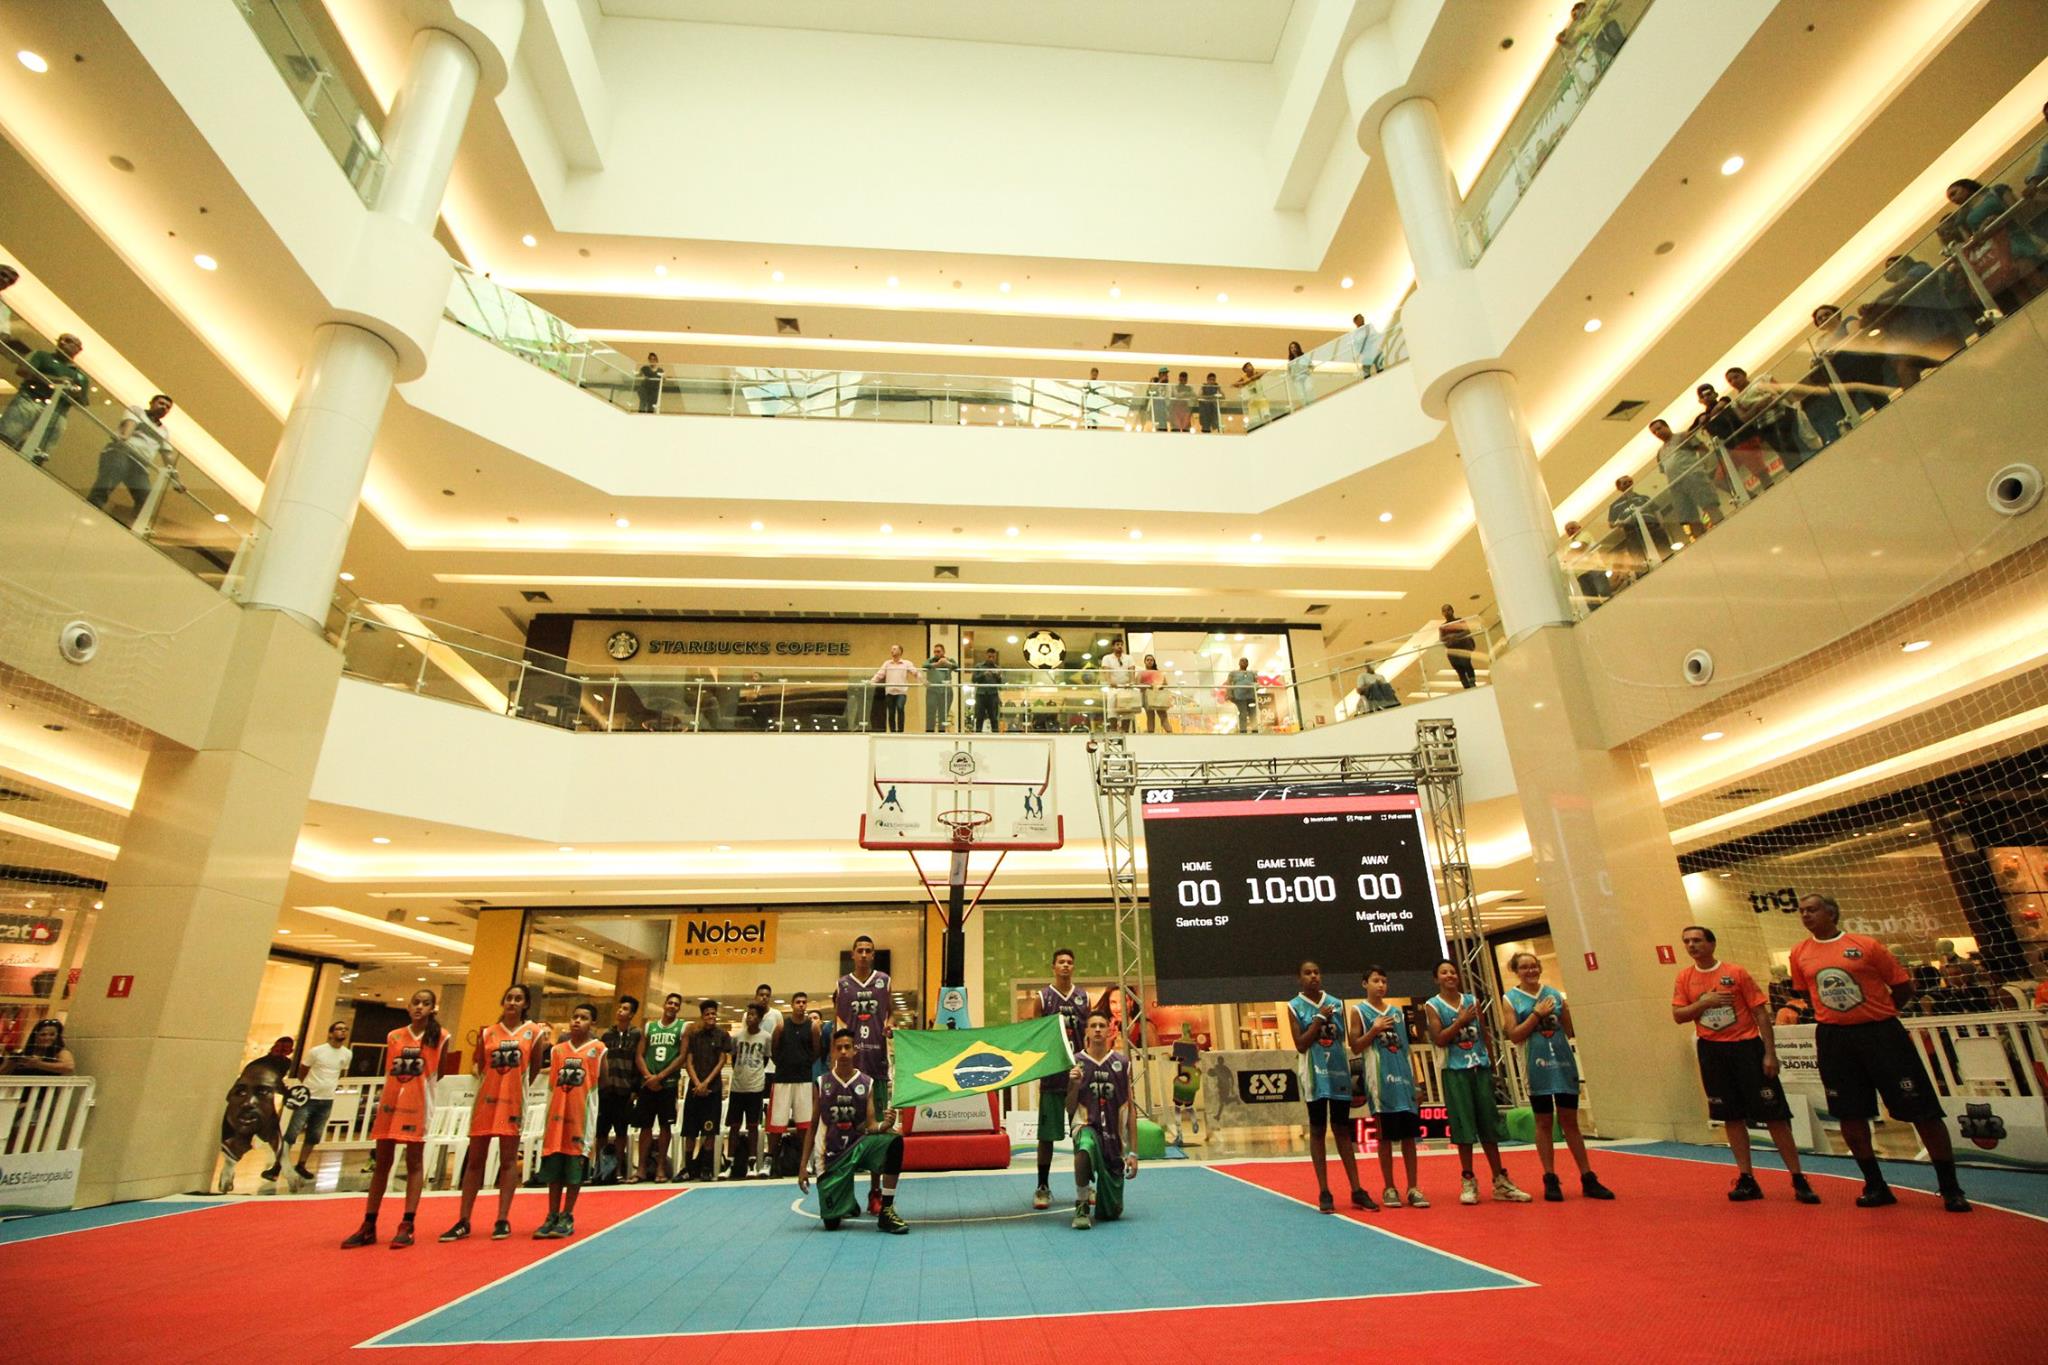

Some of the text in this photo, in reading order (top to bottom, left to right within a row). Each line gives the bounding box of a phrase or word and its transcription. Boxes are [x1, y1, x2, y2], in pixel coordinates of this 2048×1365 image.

[649, 639, 851, 656] STARBUCKS COFFEE
[1182, 861, 1213, 871] HOME
[1256, 857, 1316, 869] GAME TIME
[1361, 855, 1389, 866] AWAY
[1177, 879, 1222, 907] 00
[1246, 875, 1337, 905] 10:00
[1357, 873, 1403, 900] 00
[1748, 887, 1799, 914] tng
[1176, 915, 1230, 928] Santos SP
[1356, 910, 1414, 923] Marleys do
[687, 920, 766, 943] Nobel
[1369, 922, 1405, 933] Imirim
[684, 946, 765, 956] MEGA STORE
[650, 1032, 677, 1046] CELTICS
[655, 1047, 667, 1062] 9
[1464, 1052, 1481, 1069] 23
[933, 1109, 987, 1120] AES Eletropaulo
[22, 1168, 73, 1184] Eletropaulo
